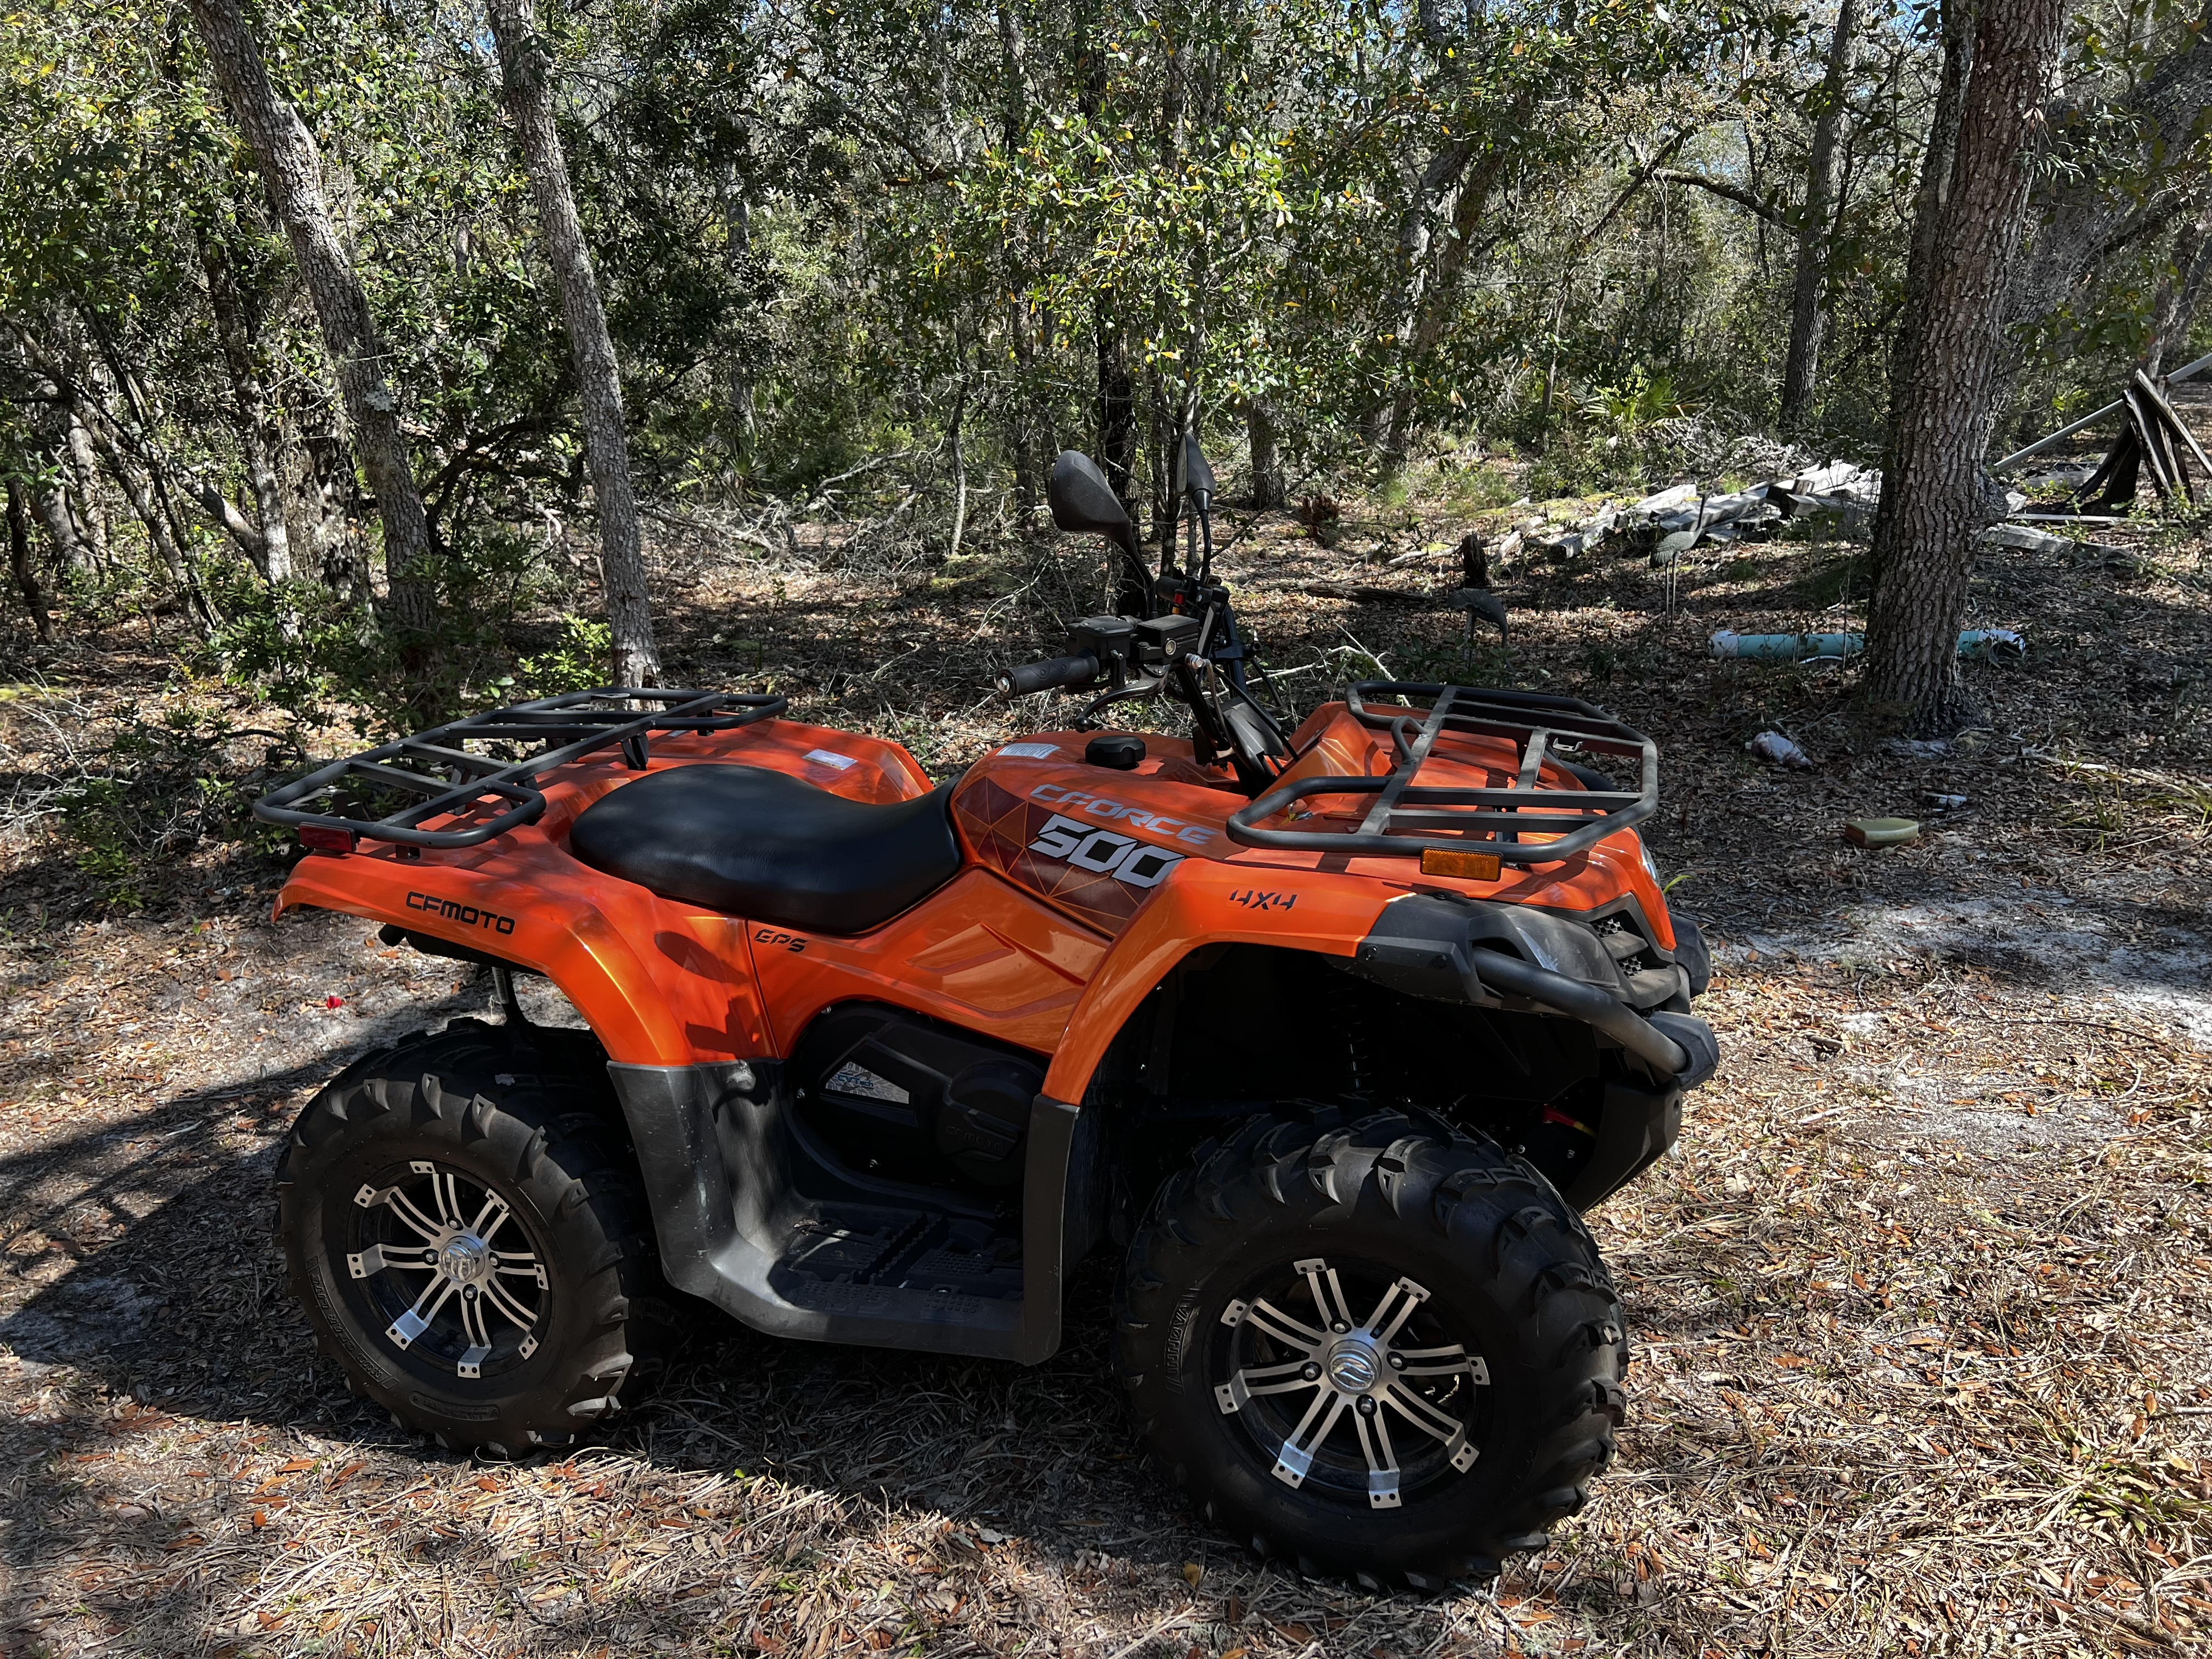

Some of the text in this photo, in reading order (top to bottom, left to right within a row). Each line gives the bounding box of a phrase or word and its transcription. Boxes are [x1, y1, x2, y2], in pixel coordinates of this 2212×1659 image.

[1030, 783, 1218, 844] CFORCE
[1028, 813, 1186, 888] 500
[406, 891, 515, 935] CFMOTO
[754, 929, 808, 952] EPS
[309, 1272, 332, 1310] LITE
[356, 1353, 384, 1379] MUD
